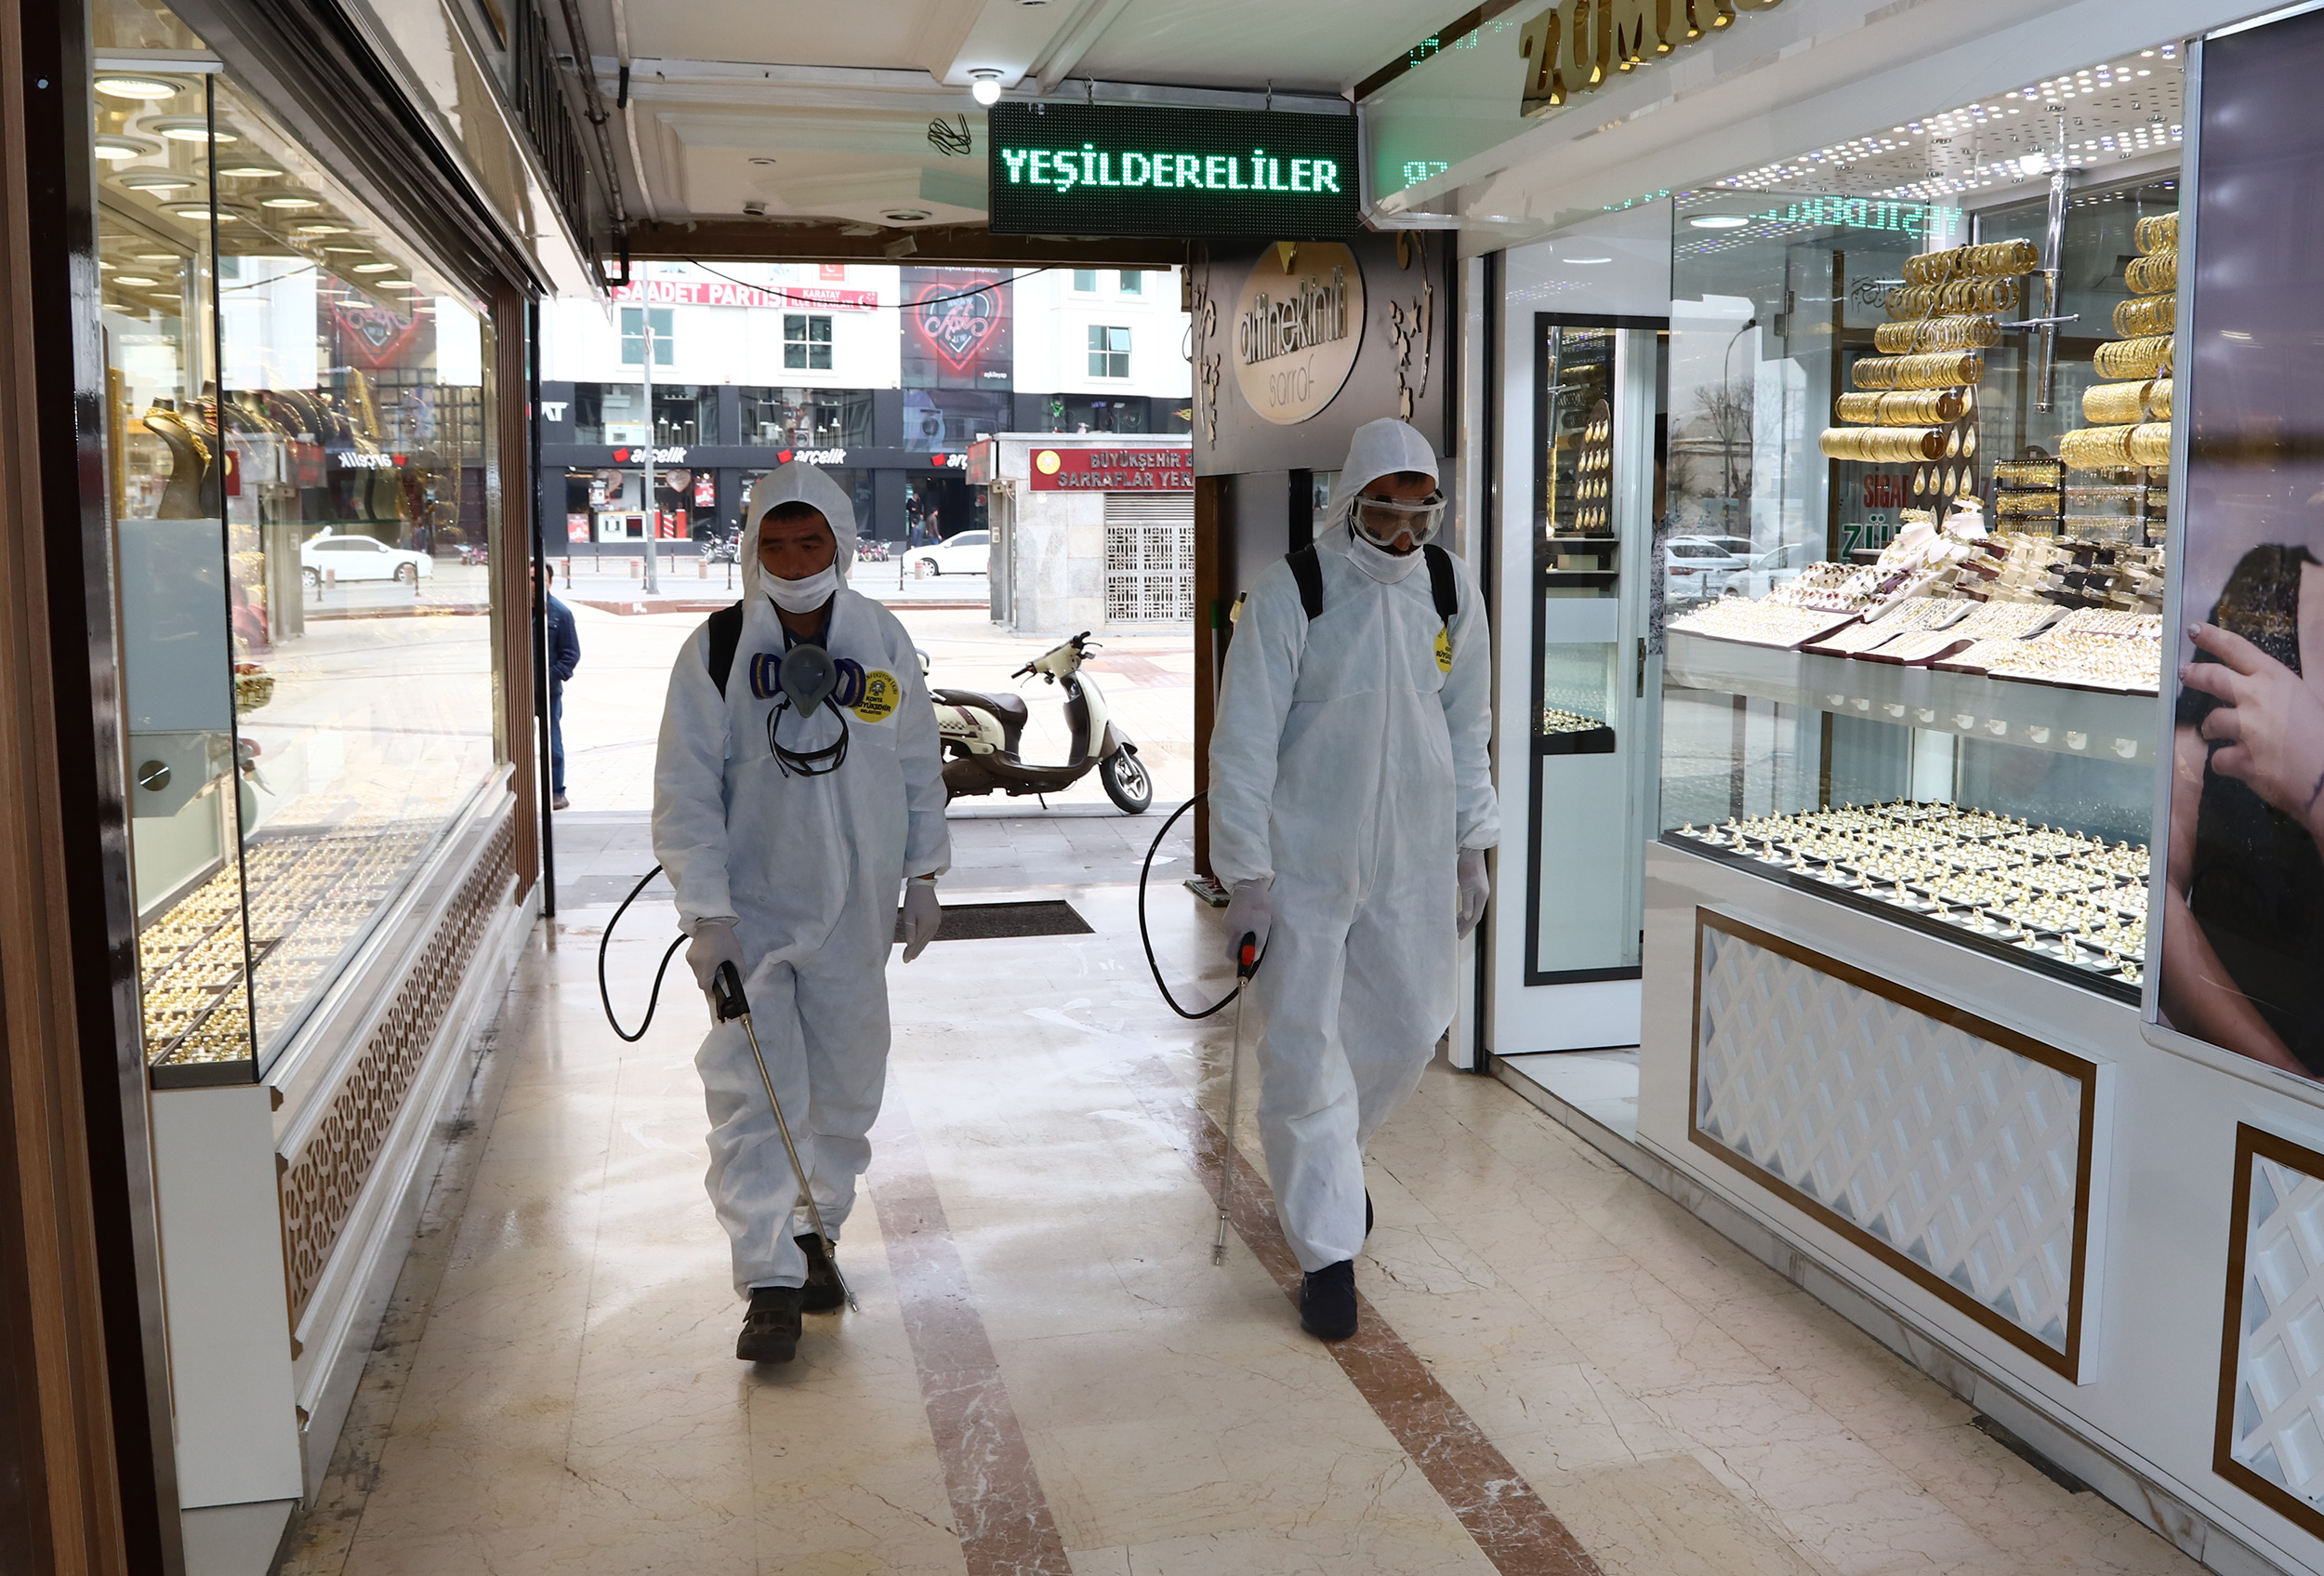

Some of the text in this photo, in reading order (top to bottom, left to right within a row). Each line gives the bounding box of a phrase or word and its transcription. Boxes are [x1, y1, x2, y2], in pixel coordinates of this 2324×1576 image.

[1003, 143, 1340, 192] YEŞİLDERELİLER
[615, 280, 702, 303] SAADET
[803, 289, 840, 299] KARATAY
[1270, 353, 1314, 407] sarraf
[794, 448, 847, 466] arçelik
[946, 453, 968, 470] arç
[1090, 450, 1182, 471] BÜYÜKŞEHİR
[1058, 471, 1195, 487] SARRAFLAR YER
